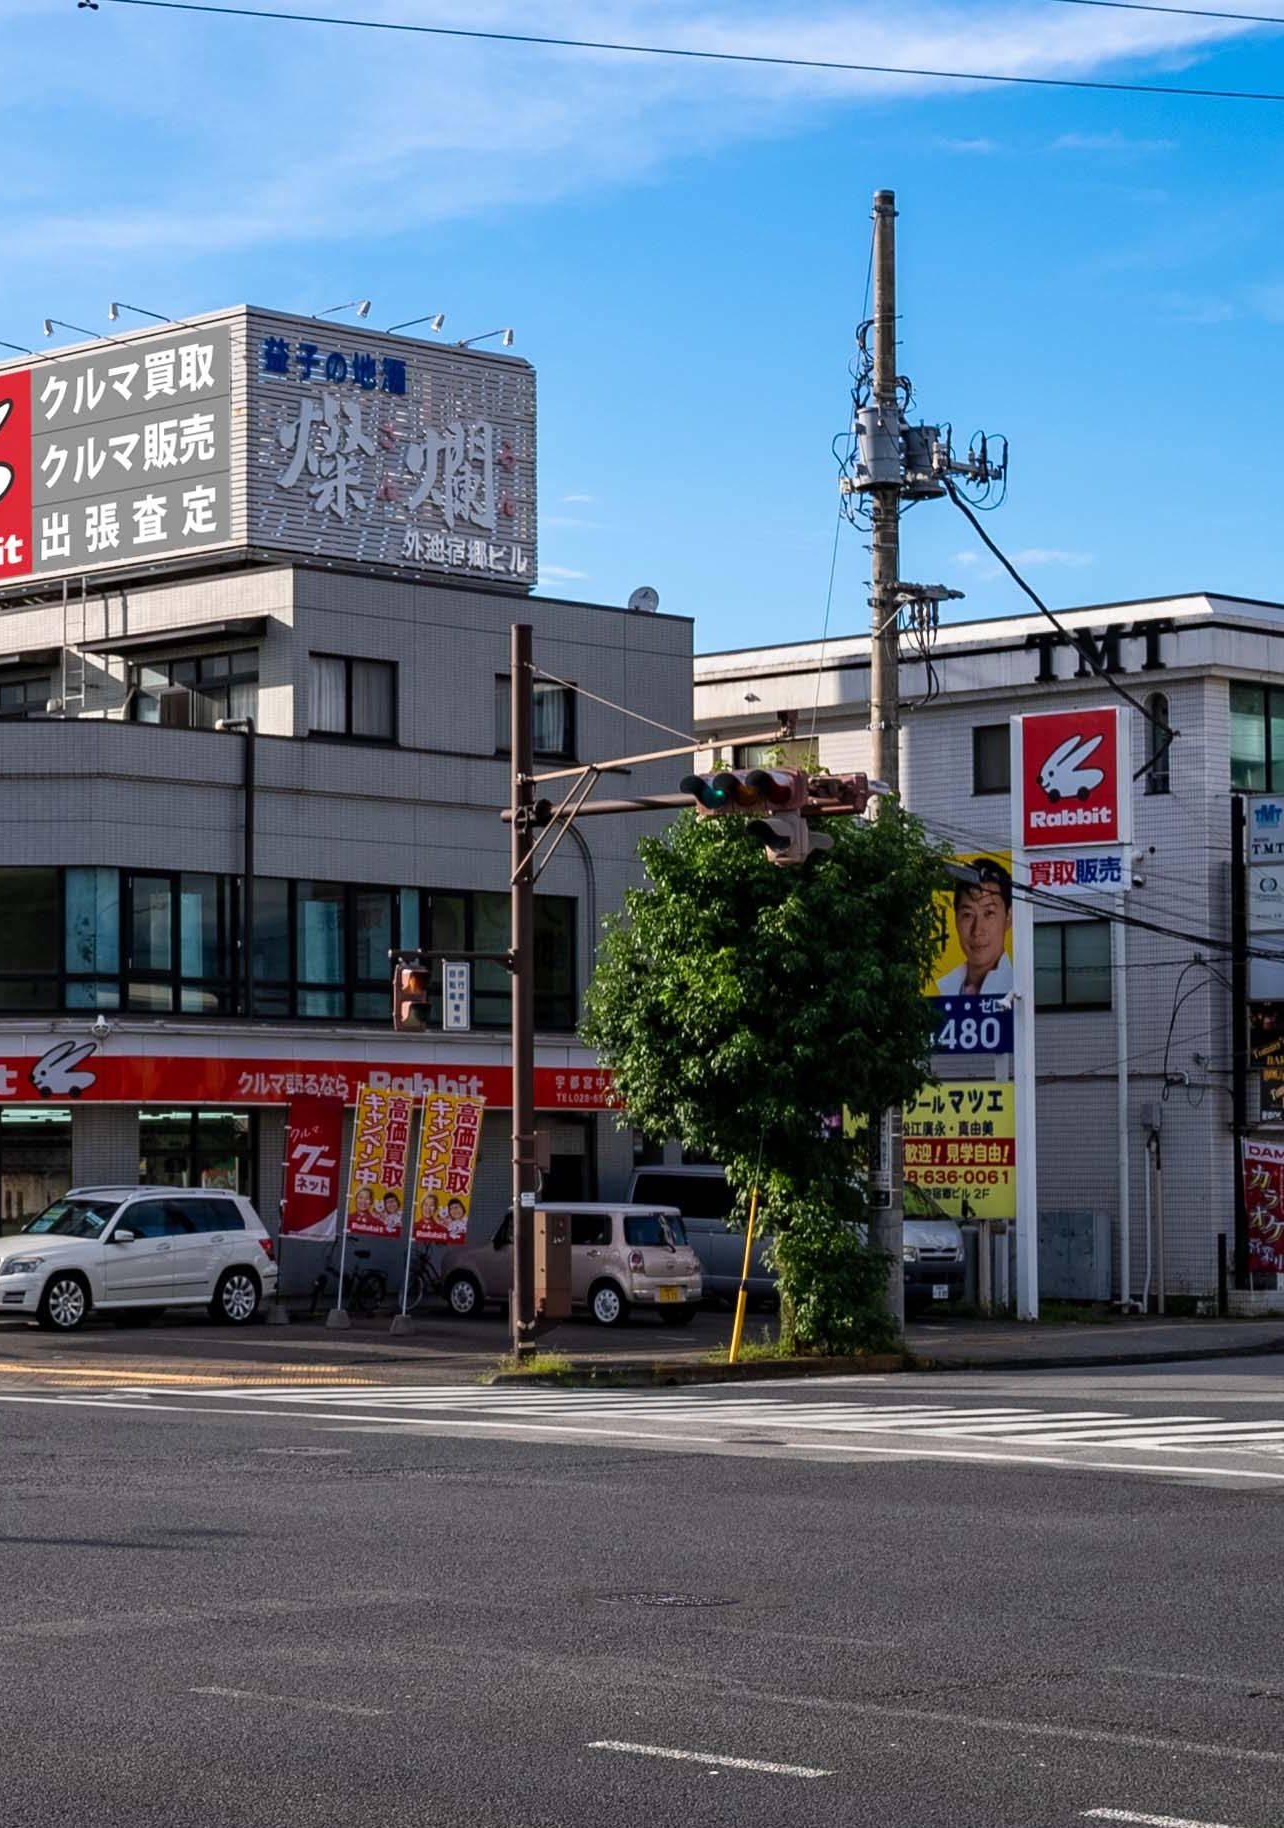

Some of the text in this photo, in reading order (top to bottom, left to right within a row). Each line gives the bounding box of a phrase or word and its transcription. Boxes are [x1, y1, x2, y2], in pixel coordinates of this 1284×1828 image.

[40, 344, 215, 420] クルマ買取
[41, 413, 215, 489] クルマ販売
[41, 485, 217, 561] 出張査定
[403, 530, 528, 573] 外池宿郷ビル
[1029, 806, 1112, 829] Rabbit
[1028, 856, 1122, 888] 買取販売
[938, 1018, 1000, 1049] 480
[238, 1071, 348, 1099] クルマ売るなら
[291, 1143, 337, 1174] グー
[355, 1092, 386, 1187] キャンペーン中
[380, 1096, 413, 1190] 高価買取
[421, 1098, 454, 1192] キャンペーン中
[445, 1102, 481, 1196] 高価買取
[296, 1177, 329, 1194] ネット
